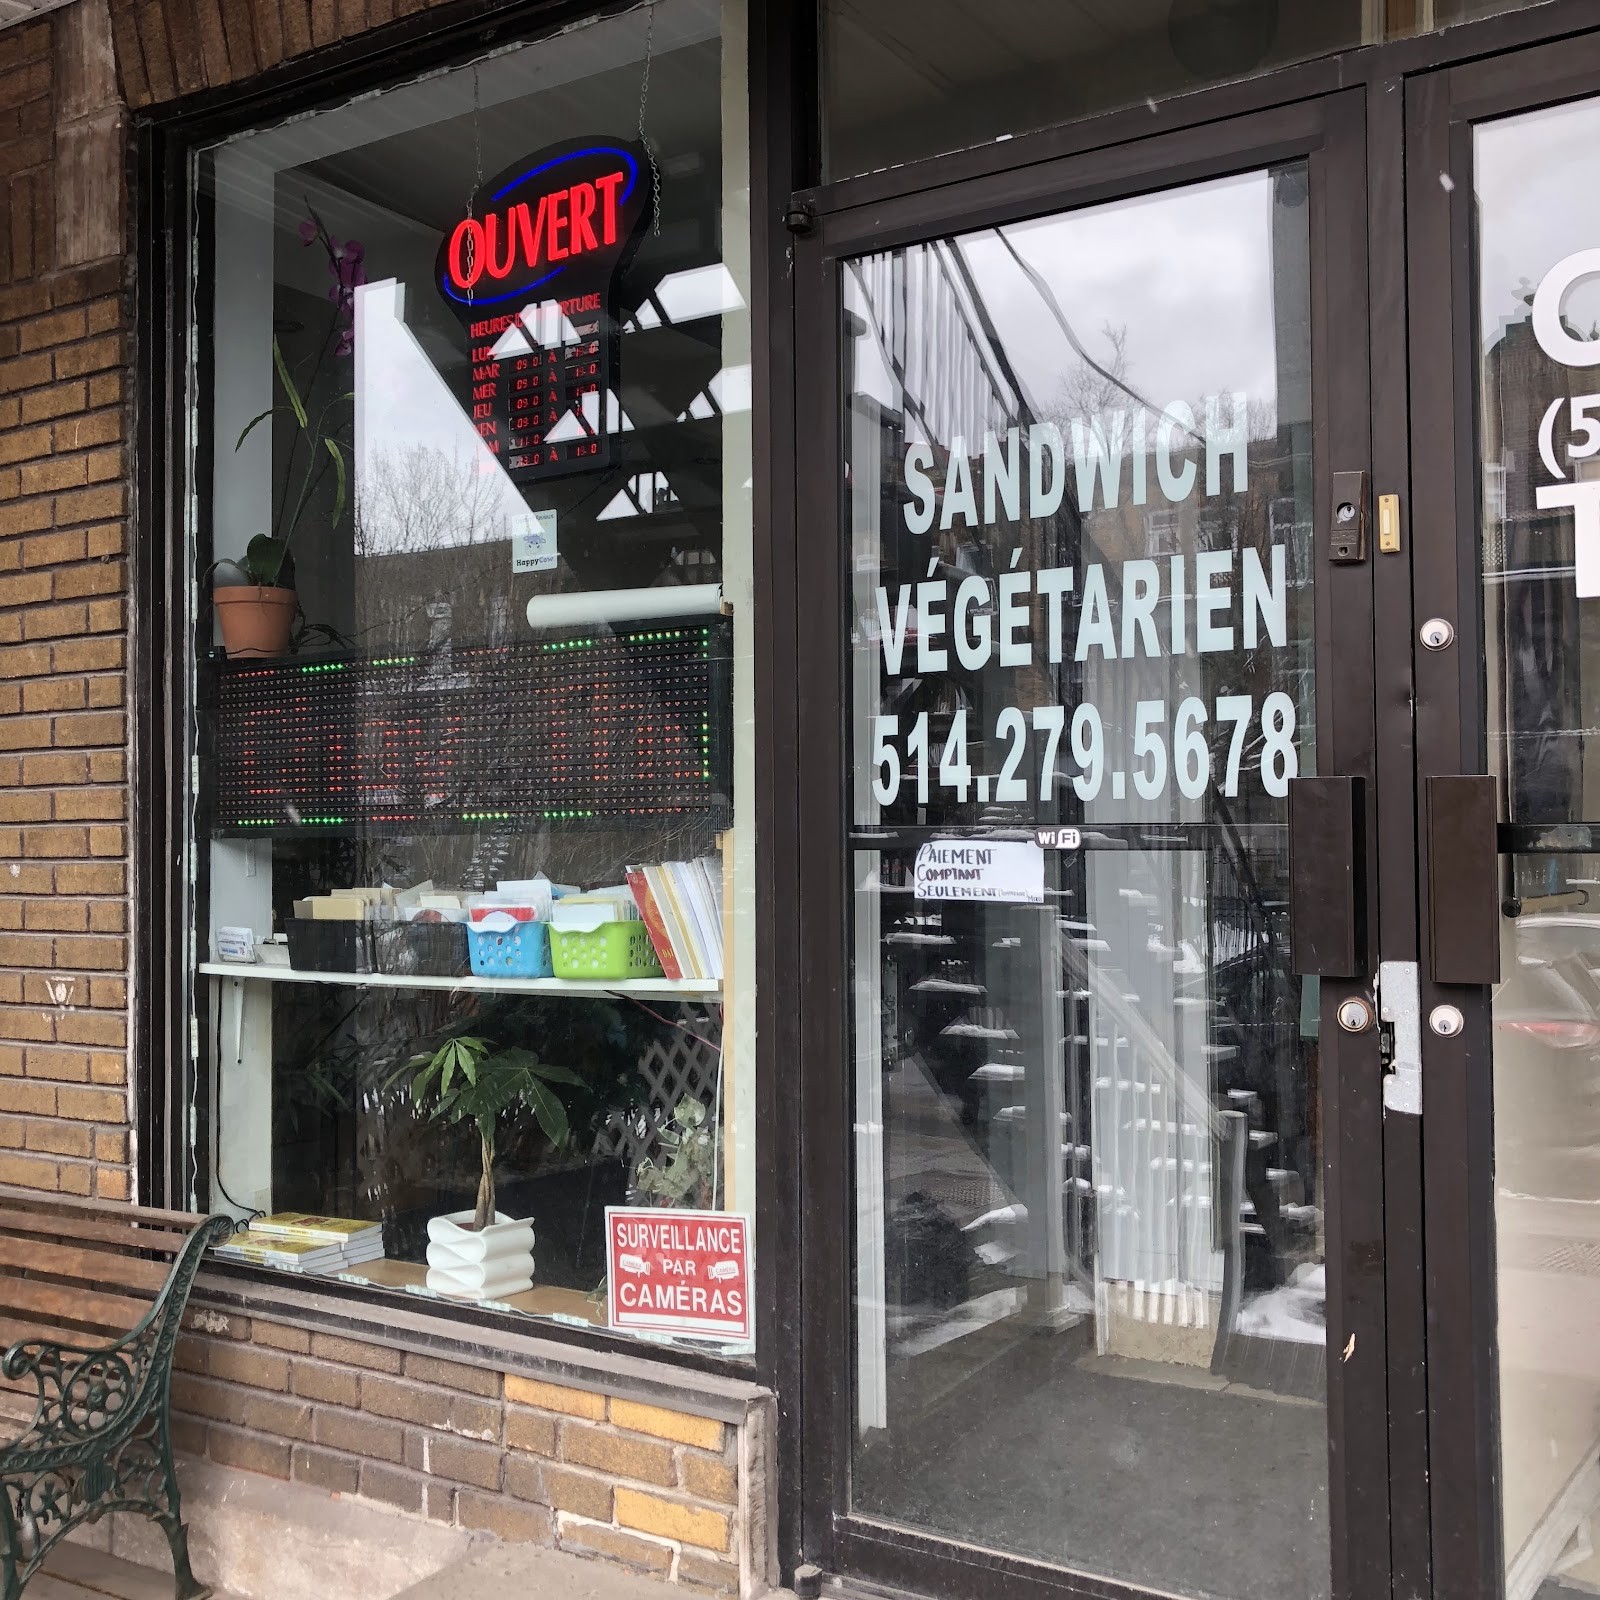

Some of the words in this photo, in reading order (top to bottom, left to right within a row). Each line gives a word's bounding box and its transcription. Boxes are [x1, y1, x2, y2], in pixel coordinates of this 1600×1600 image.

[448, 171, 624, 290] OUVERT
[470, 313, 513, 338] HEURES
[472, 363, 501, 381] MAR
[472, 382, 497, 400] MER
[902, 391, 1249, 535] SANDWICH
[874, 543, 1289, 677] VÉGÉTARIEN
[871, 690, 1299, 807] 514.279.5678
[918, 843, 997, 866] PAIEMENT
[916, 864, 985, 882] COMPTANT
[917, 882, 998, 898] SEULEMENT
[616, 1222, 742, 1255] SURVEILLANCE
[662, 1258, 697, 1276] PAR
[619, 1279, 743, 1317] CAMÉRAS
